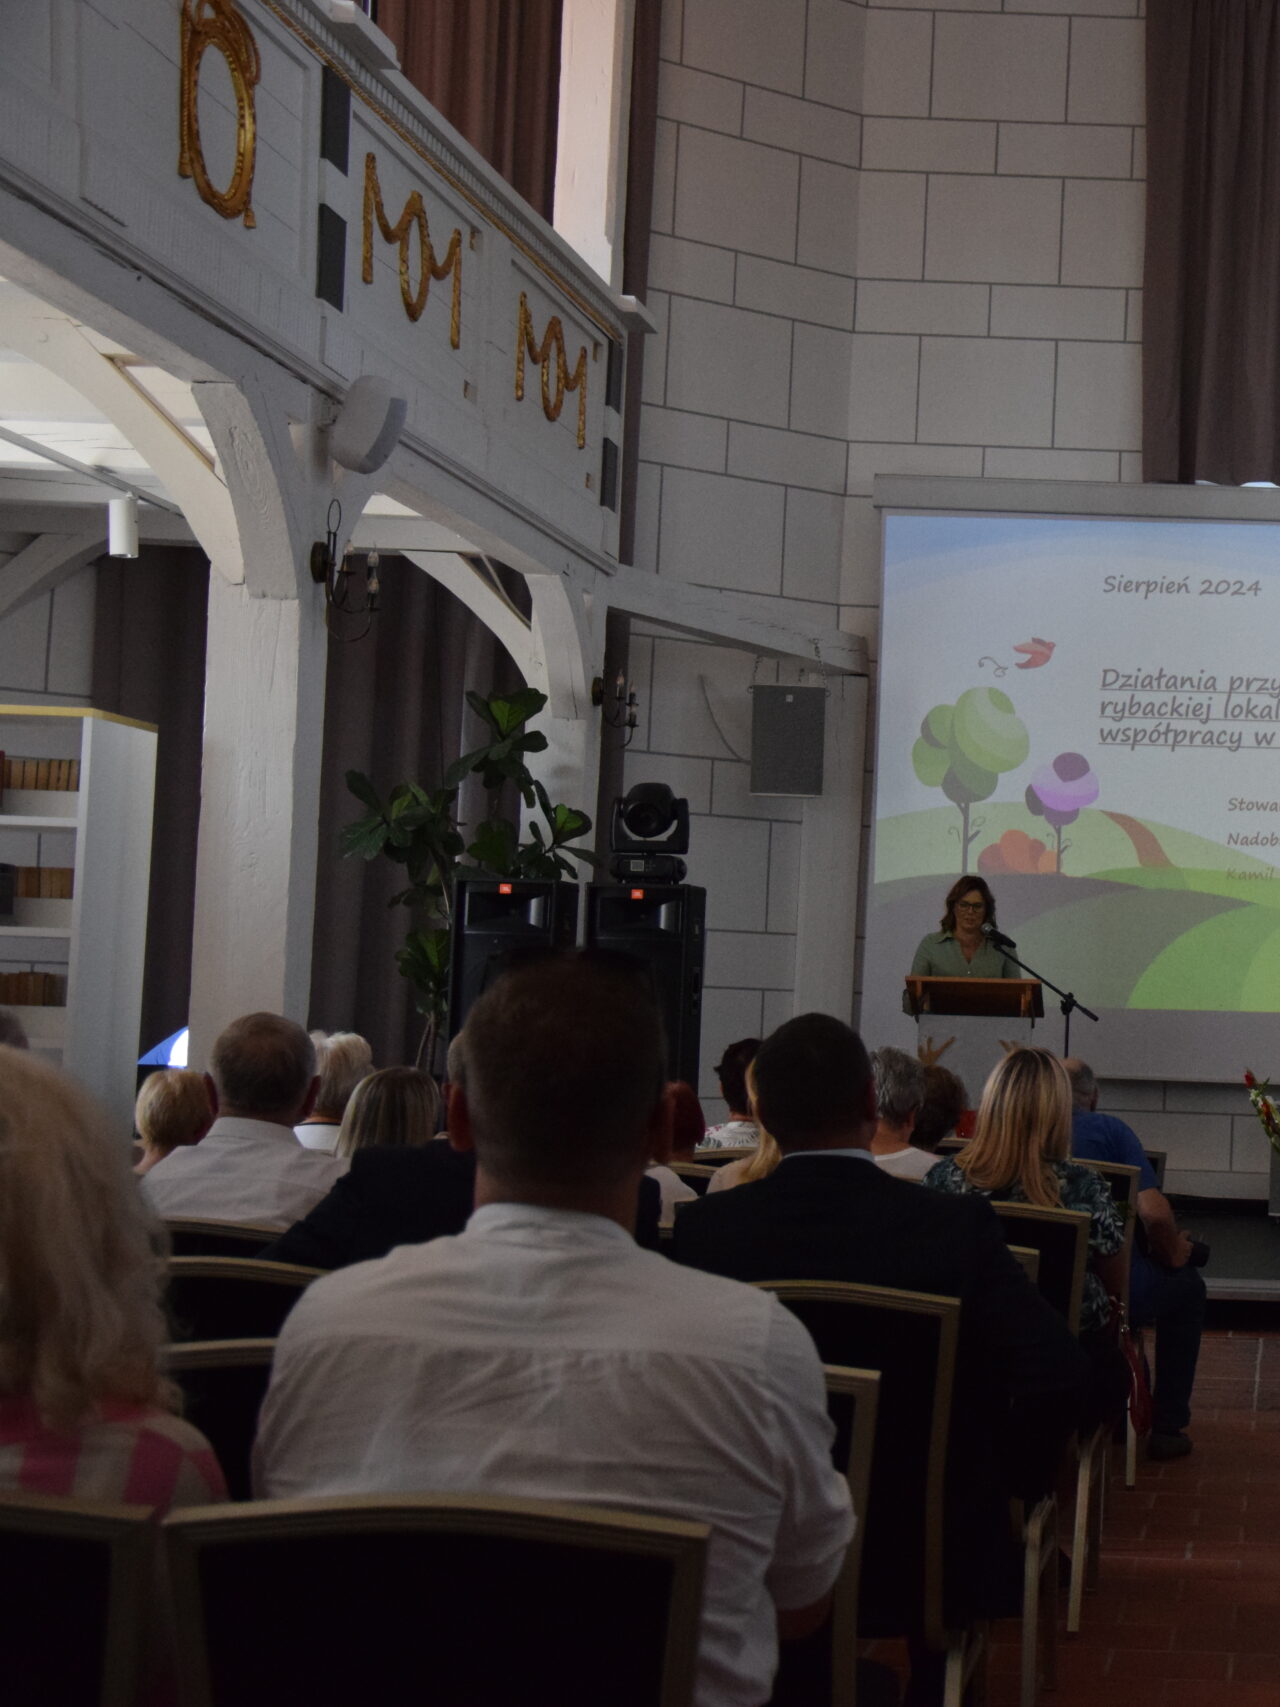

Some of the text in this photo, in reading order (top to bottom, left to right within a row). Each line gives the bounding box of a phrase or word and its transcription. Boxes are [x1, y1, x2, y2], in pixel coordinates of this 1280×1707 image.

[1103, 574, 1262, 599] Sierpień 2024
[1101, 667, 1218, 691] Działania
[1100, 694, 1213, 724] rybackiej
[1100, 722, 1243, 752] współpracy
[1254, 731, 1276, 747] w
[1226, 867, 1275, 882] Kamil
